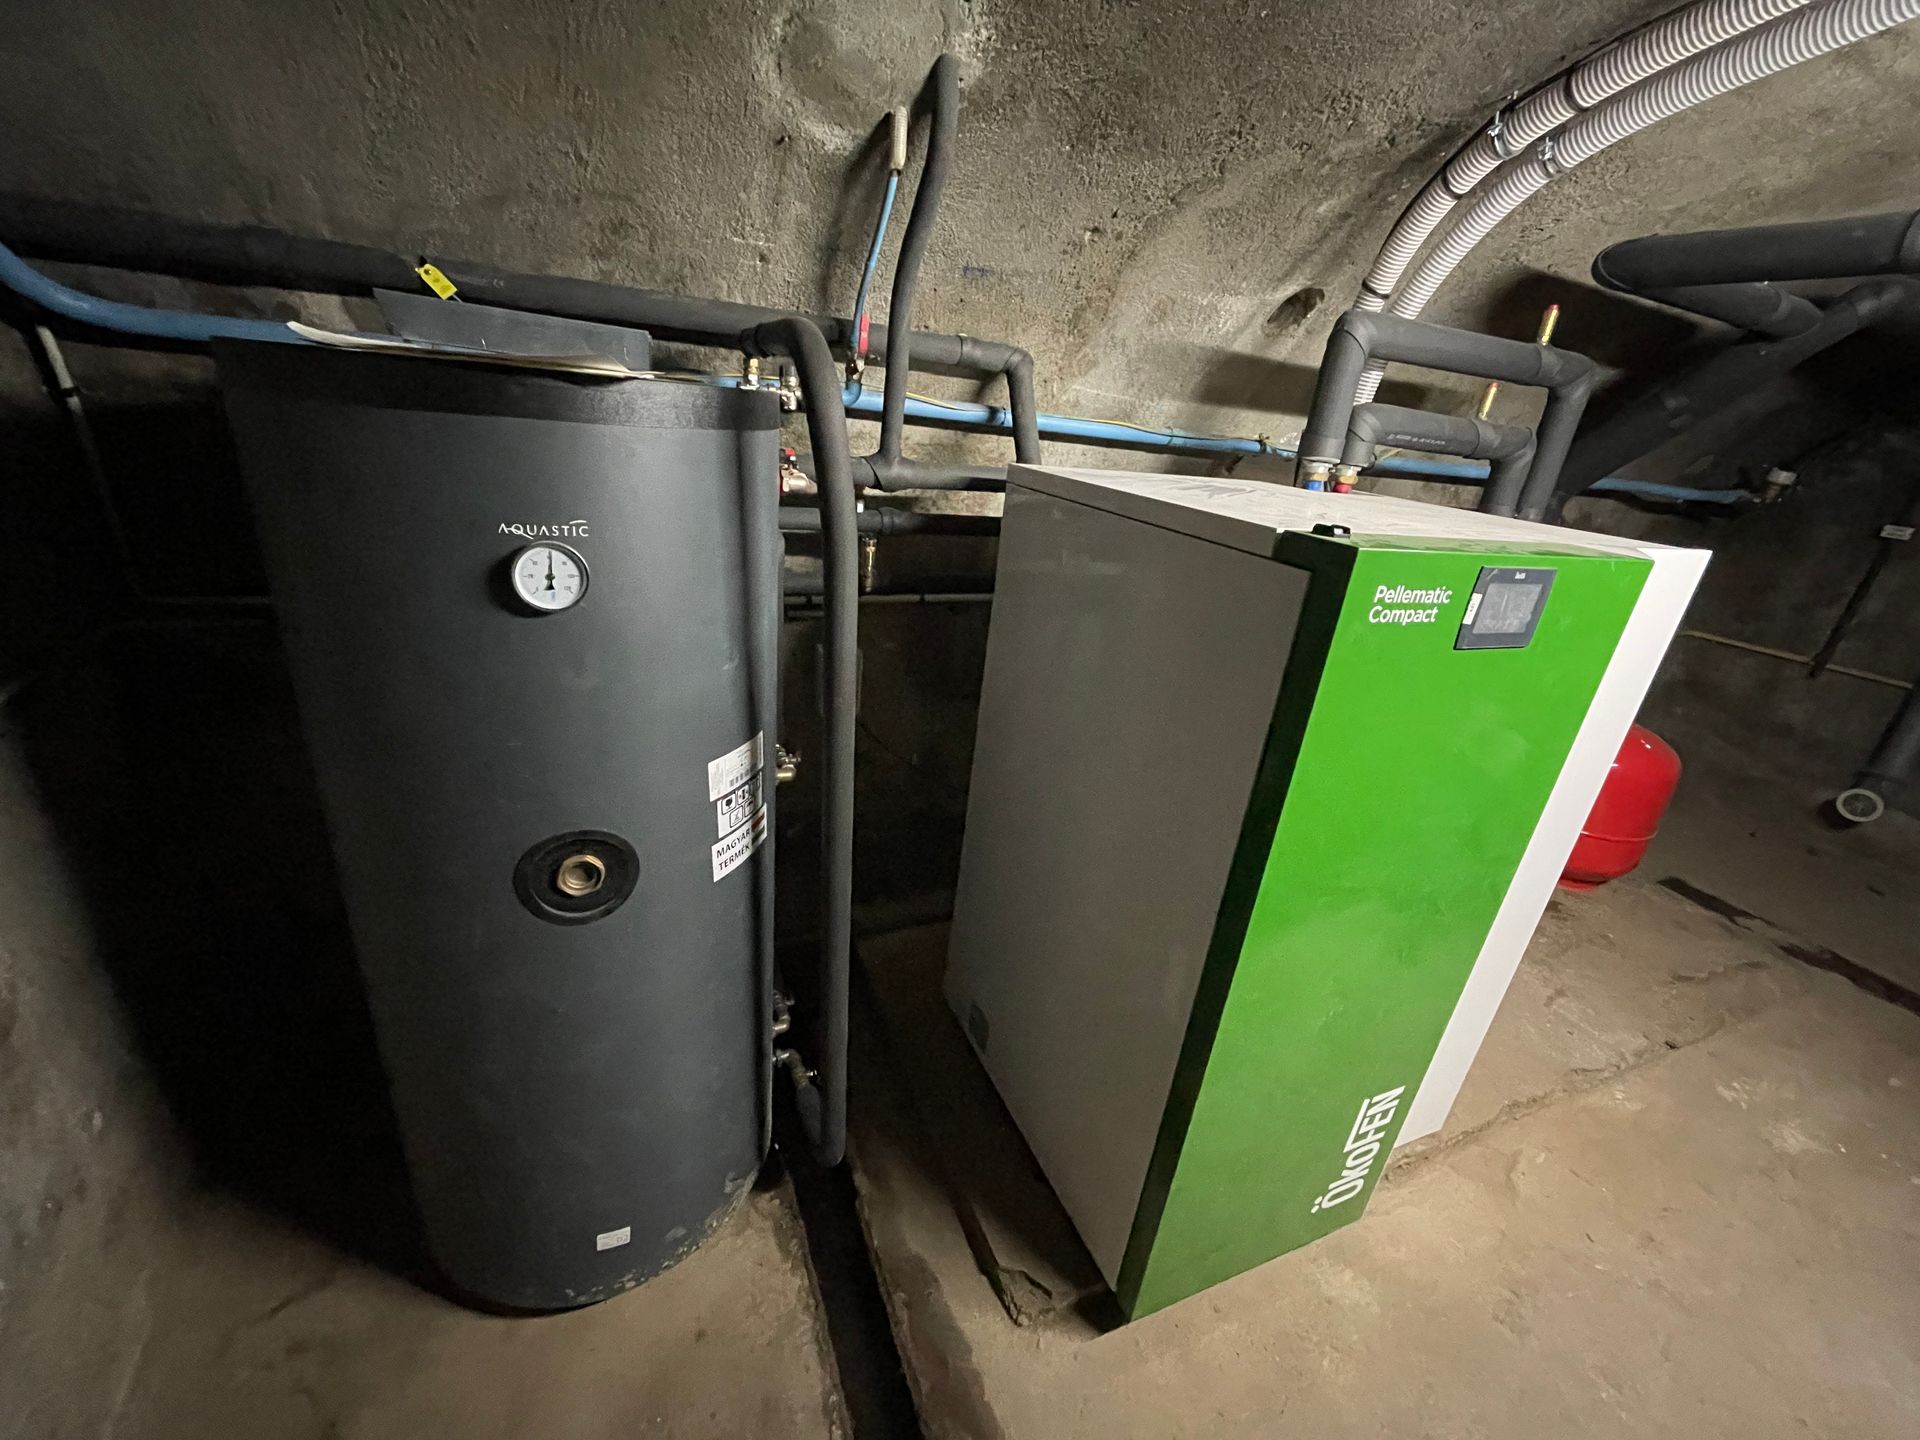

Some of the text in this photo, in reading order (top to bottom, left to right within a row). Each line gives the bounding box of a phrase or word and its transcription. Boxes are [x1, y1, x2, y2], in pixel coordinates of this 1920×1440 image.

[498, 520, 590, 540] AQUASTIC
[1374, 585, 1453, 604] Pellematic
[1369, 605, 1439, 626] Compact
[716, 827, 751, 859] MAGYAR
[718, 842, 751, 871] TERMÉK
